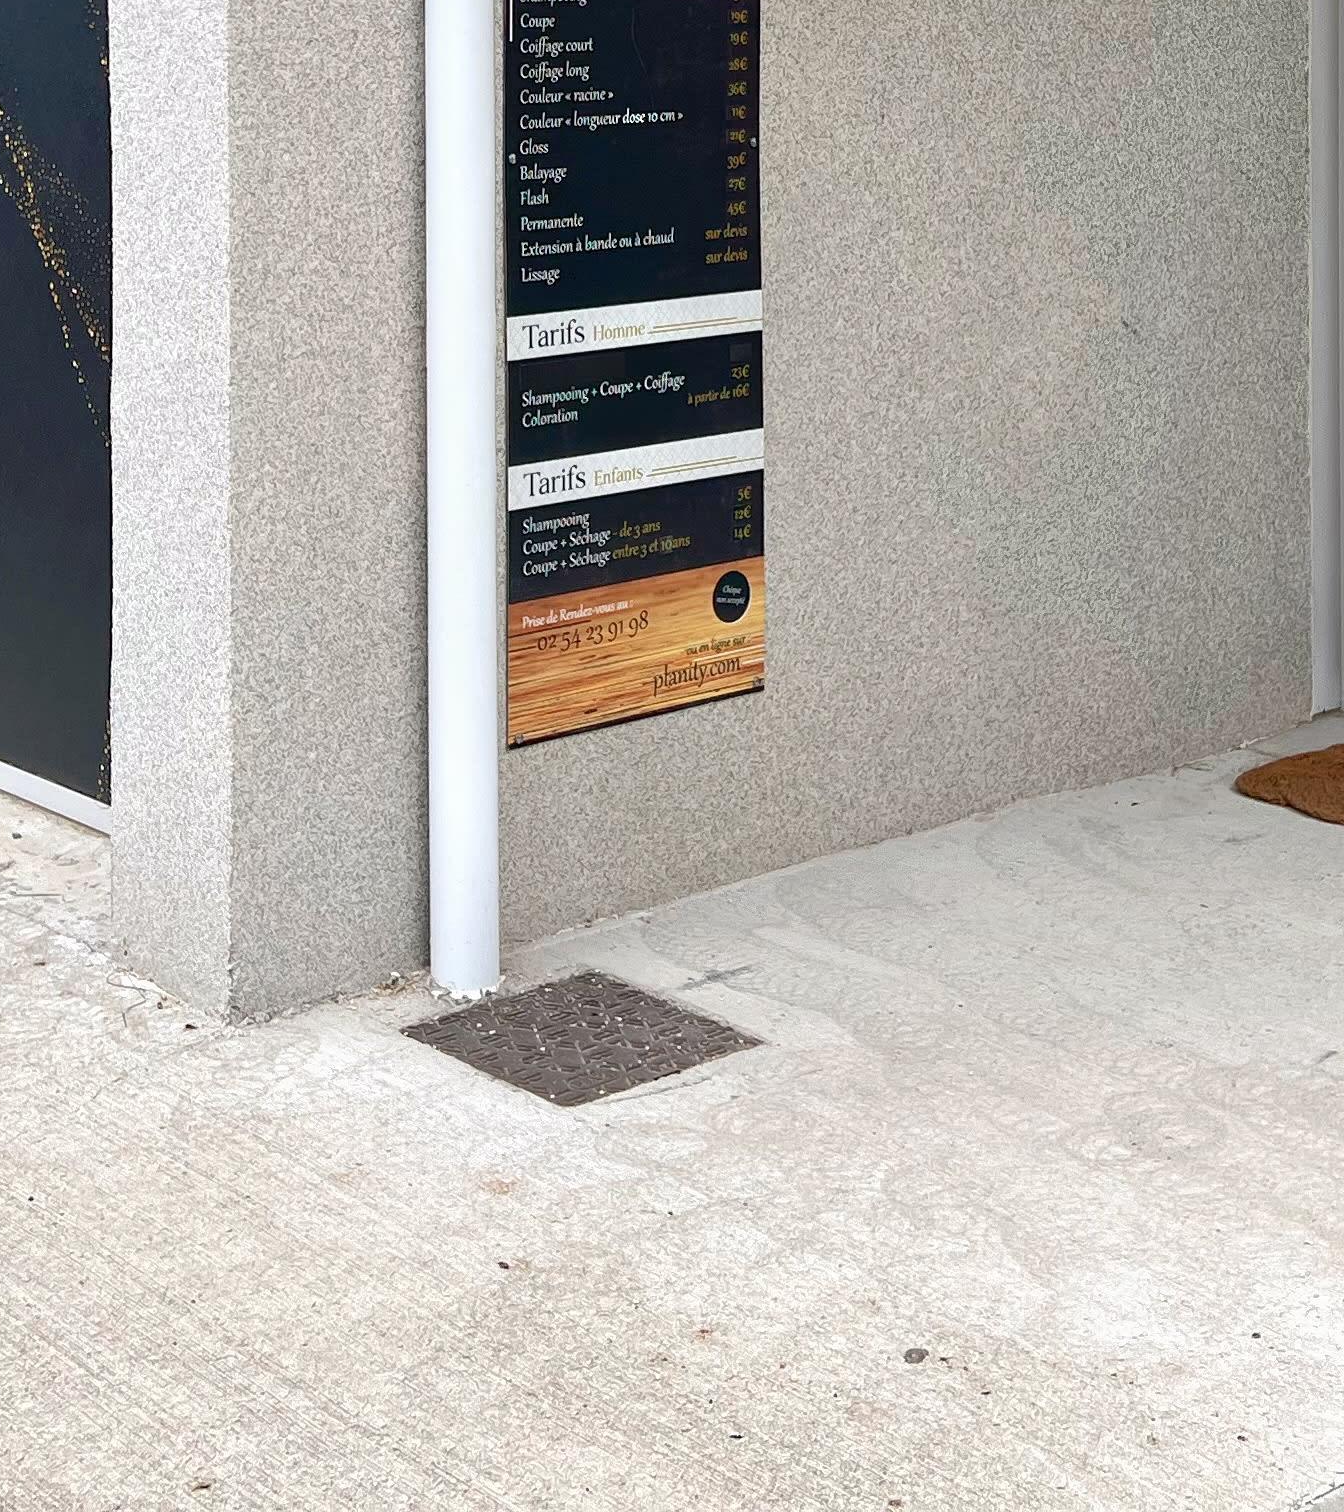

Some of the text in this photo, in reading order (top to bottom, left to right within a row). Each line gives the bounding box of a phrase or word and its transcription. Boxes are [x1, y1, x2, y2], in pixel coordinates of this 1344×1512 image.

[520, 13, 555, 33] Coupe
[520, 35, 593, 58] Coiffage court
[520, 60, 590, 83] Coiffage long
[520, 86, 606, 104] Couleur racine
[520, 107, 676, 131] Couleur longueur dose cm
[520, 138, 549, 155] Gloss
[520, 163, 567, 184] Balayage
[520, 188, 549, 206] Flash
[520, 213, 584, 232] Permanente
[520, 227, 675, 257] Extension bande ou chaud
[521, 267, 561, 286] Lissage
[522, 319, 646, 349] Tarifs Homme
[522, 370, 686, 408] Shampooing Coupe Coiffage
[522, 408, 579, 428] Coloration
[523, 465, 644, 497] Tarifs Enfants
[523, 512, 590, 534] Shampooing
[523, 539, 558, 556] Coupe
[569, 528, 612, 547] Séchage
[642, 521, 661, 534] ans
[523, 544, 640, 577] Coupe Séchage entre
[522, 615, 546, 629] Prise
[547, 610, 558, 624] de
[537, 609, 649, 652] 02 54 23 91 98
[653, 657, 742, 696] planity.com
